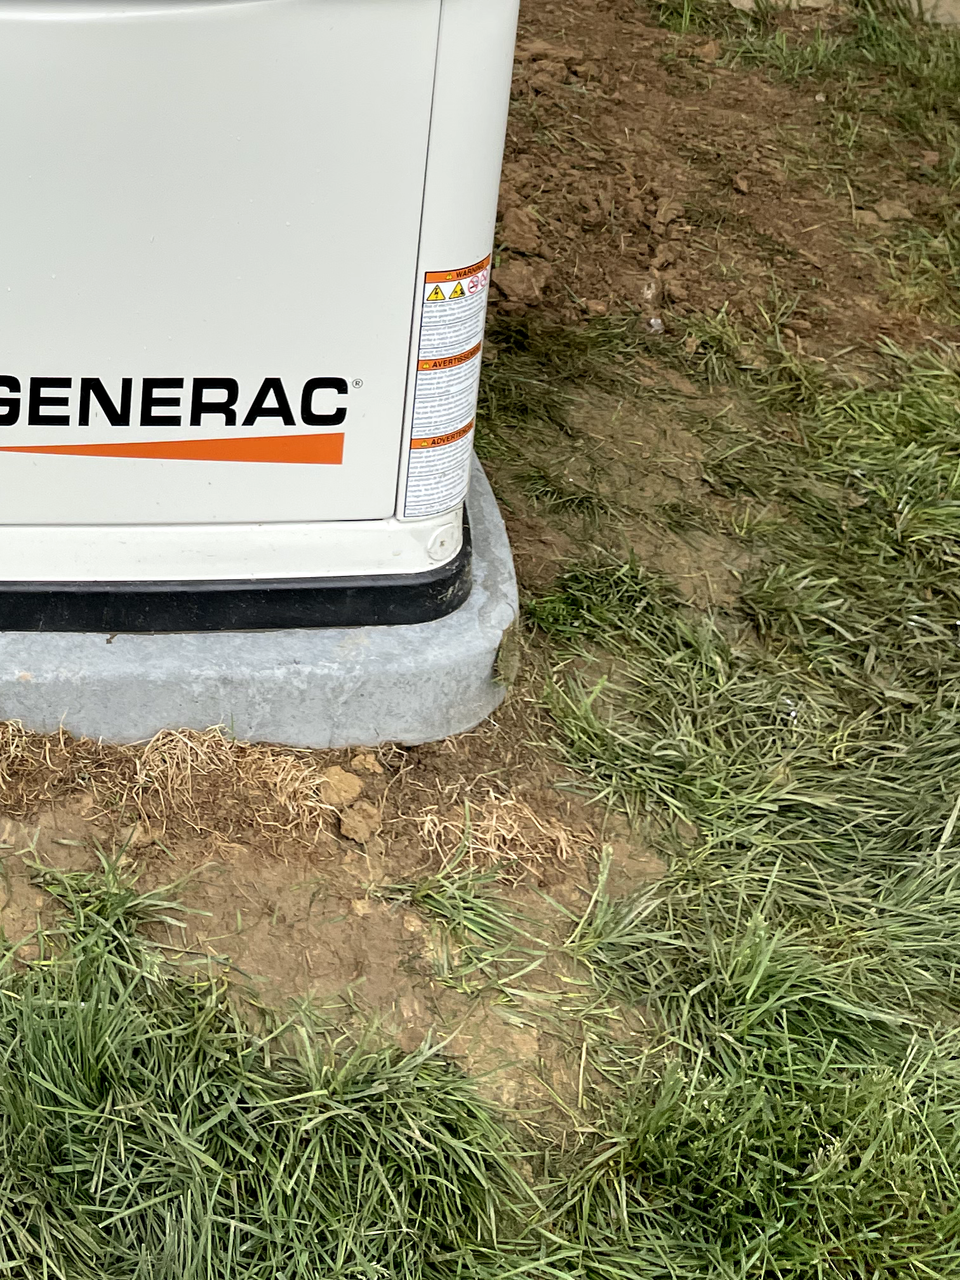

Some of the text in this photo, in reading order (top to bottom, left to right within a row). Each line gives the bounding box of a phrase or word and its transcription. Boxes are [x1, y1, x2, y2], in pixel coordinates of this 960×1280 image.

[456, 261, 485, 279] WARNING
[432, 342, 481, 368] AVERTISSE
[431, 421, 474, 446] ADVERTENC
